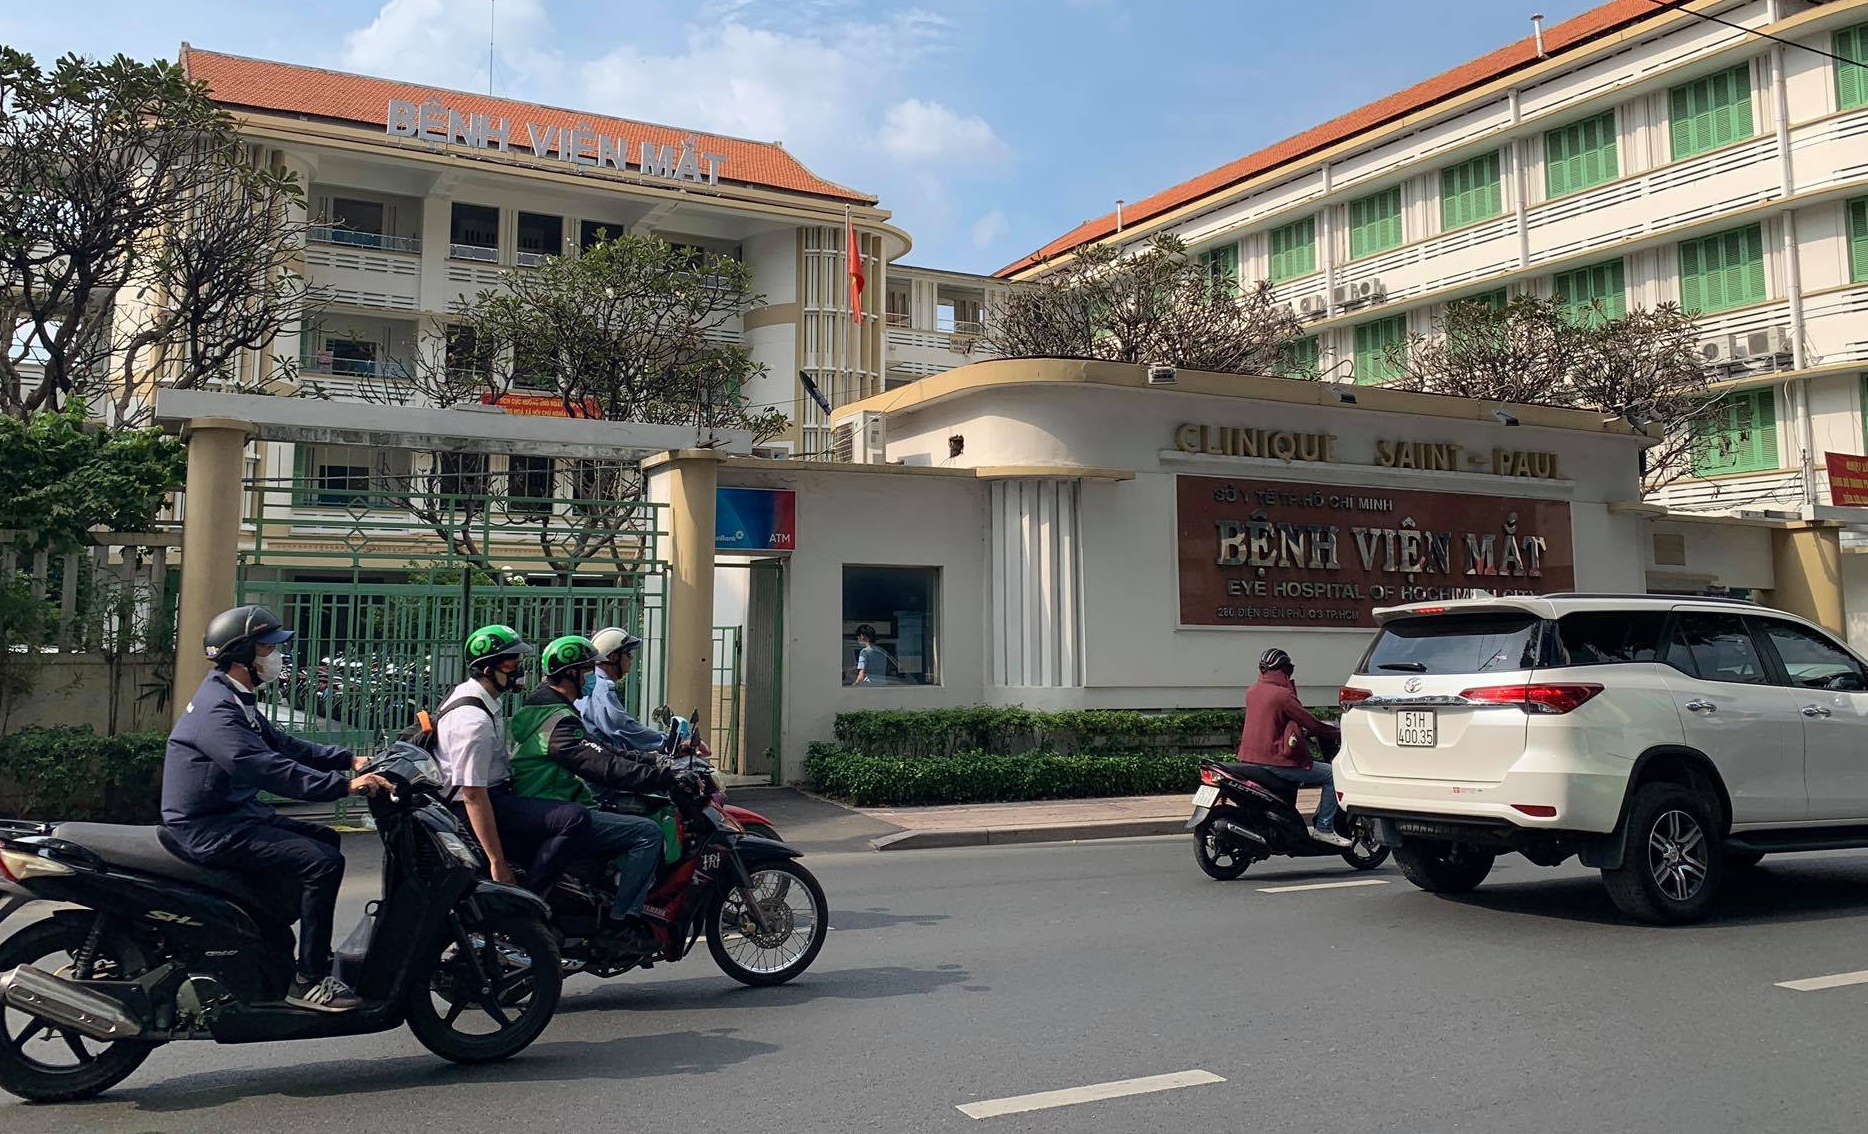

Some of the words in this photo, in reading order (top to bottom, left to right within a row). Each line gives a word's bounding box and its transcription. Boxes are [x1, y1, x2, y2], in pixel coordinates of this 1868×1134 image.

[387, 98, 509, 152] BỆNH
[526, 121, 626, 176] VIỆN
[640, 136, 727, 186] MẮT
[1175, 423, 1340, 464] CLINIQUE
[1377, 440, 1464, 471] SAINT
[1493, 447, 1566, 480] PAUL
[1358, 498, 1393, 511] MINH
[769, 533, 790, 543] ATM
[1215, 511, 1341, 577] BỆNH
[1350, 516, 1451, 583] VIỆN
[1462, 511, 1547, 577] MẮT
[1228, 579, 1267, 596] EYE
[1274, 581, 1365, 600] HOSPITAL
[1370, 584, 1395, 600] OF
[1405, 712, 1425, 728] 51H
[1398, 728, 1433, 745] 400.35
